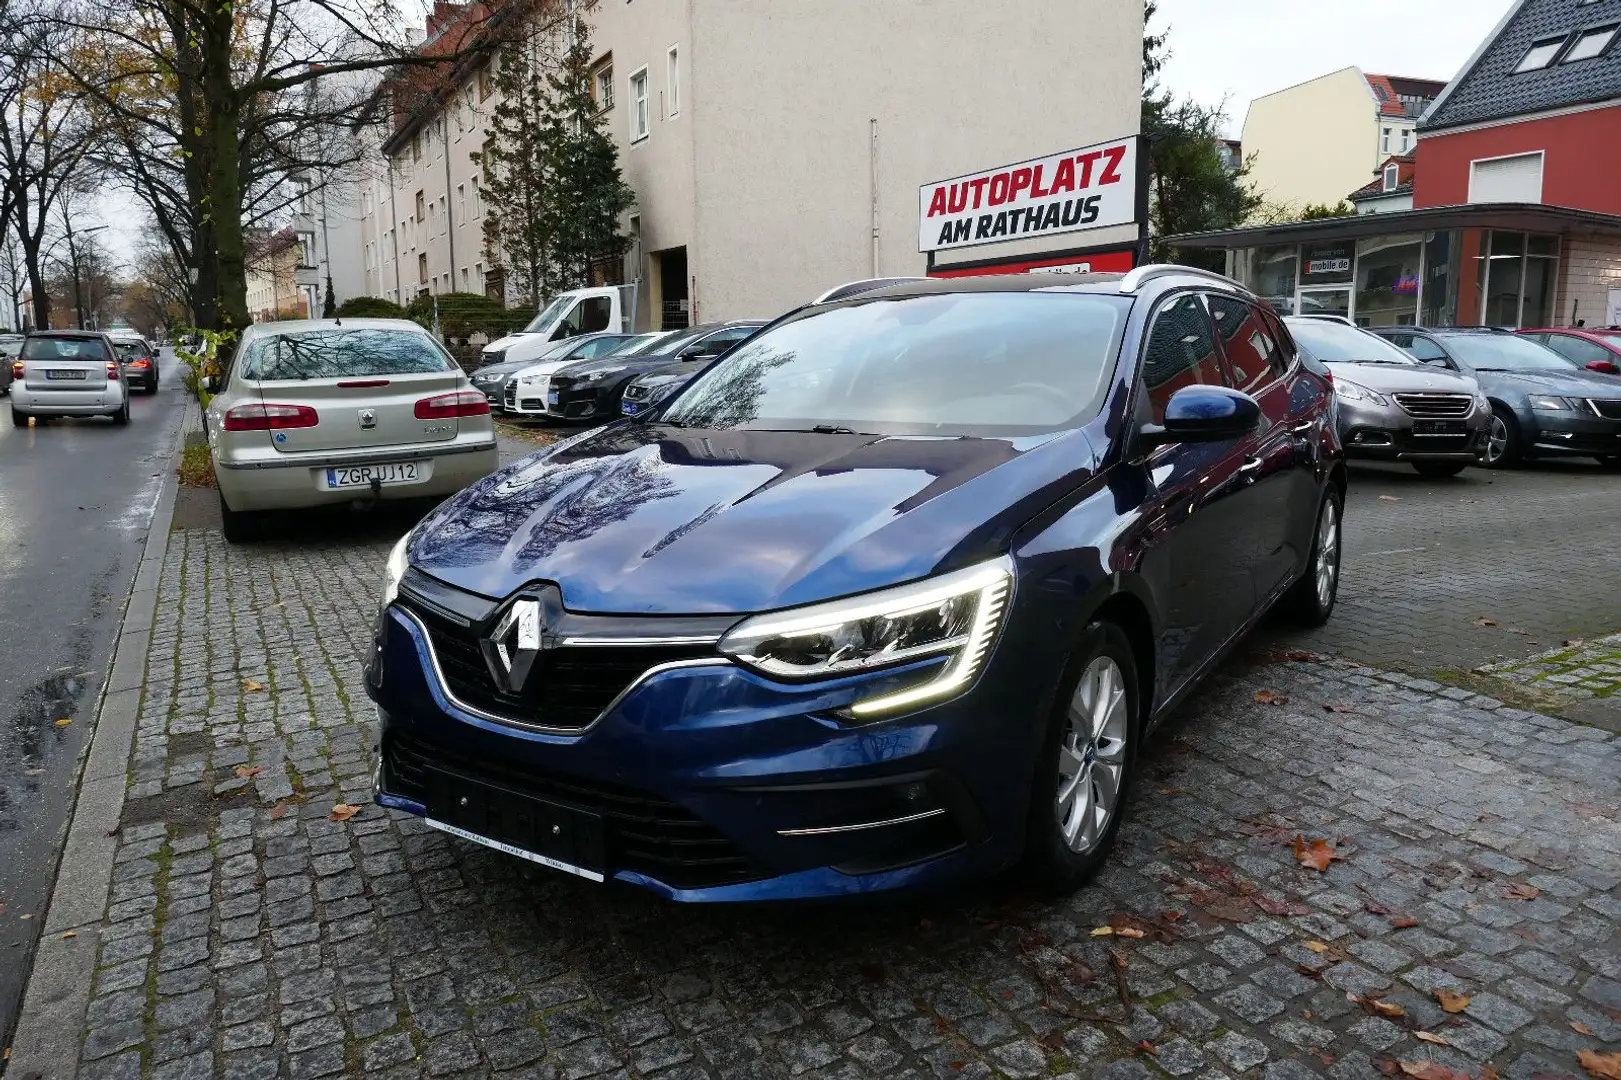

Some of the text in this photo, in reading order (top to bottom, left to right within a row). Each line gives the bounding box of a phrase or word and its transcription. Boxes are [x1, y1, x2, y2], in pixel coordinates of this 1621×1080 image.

[927, 145, 1126, 218] AUTOPLATZ
[937, 195, 1102, 245] AM RATHAUS
[1311, 260, 1348, 271] mobile.de
[338, 464, 416, 485] ZGR UJ12
